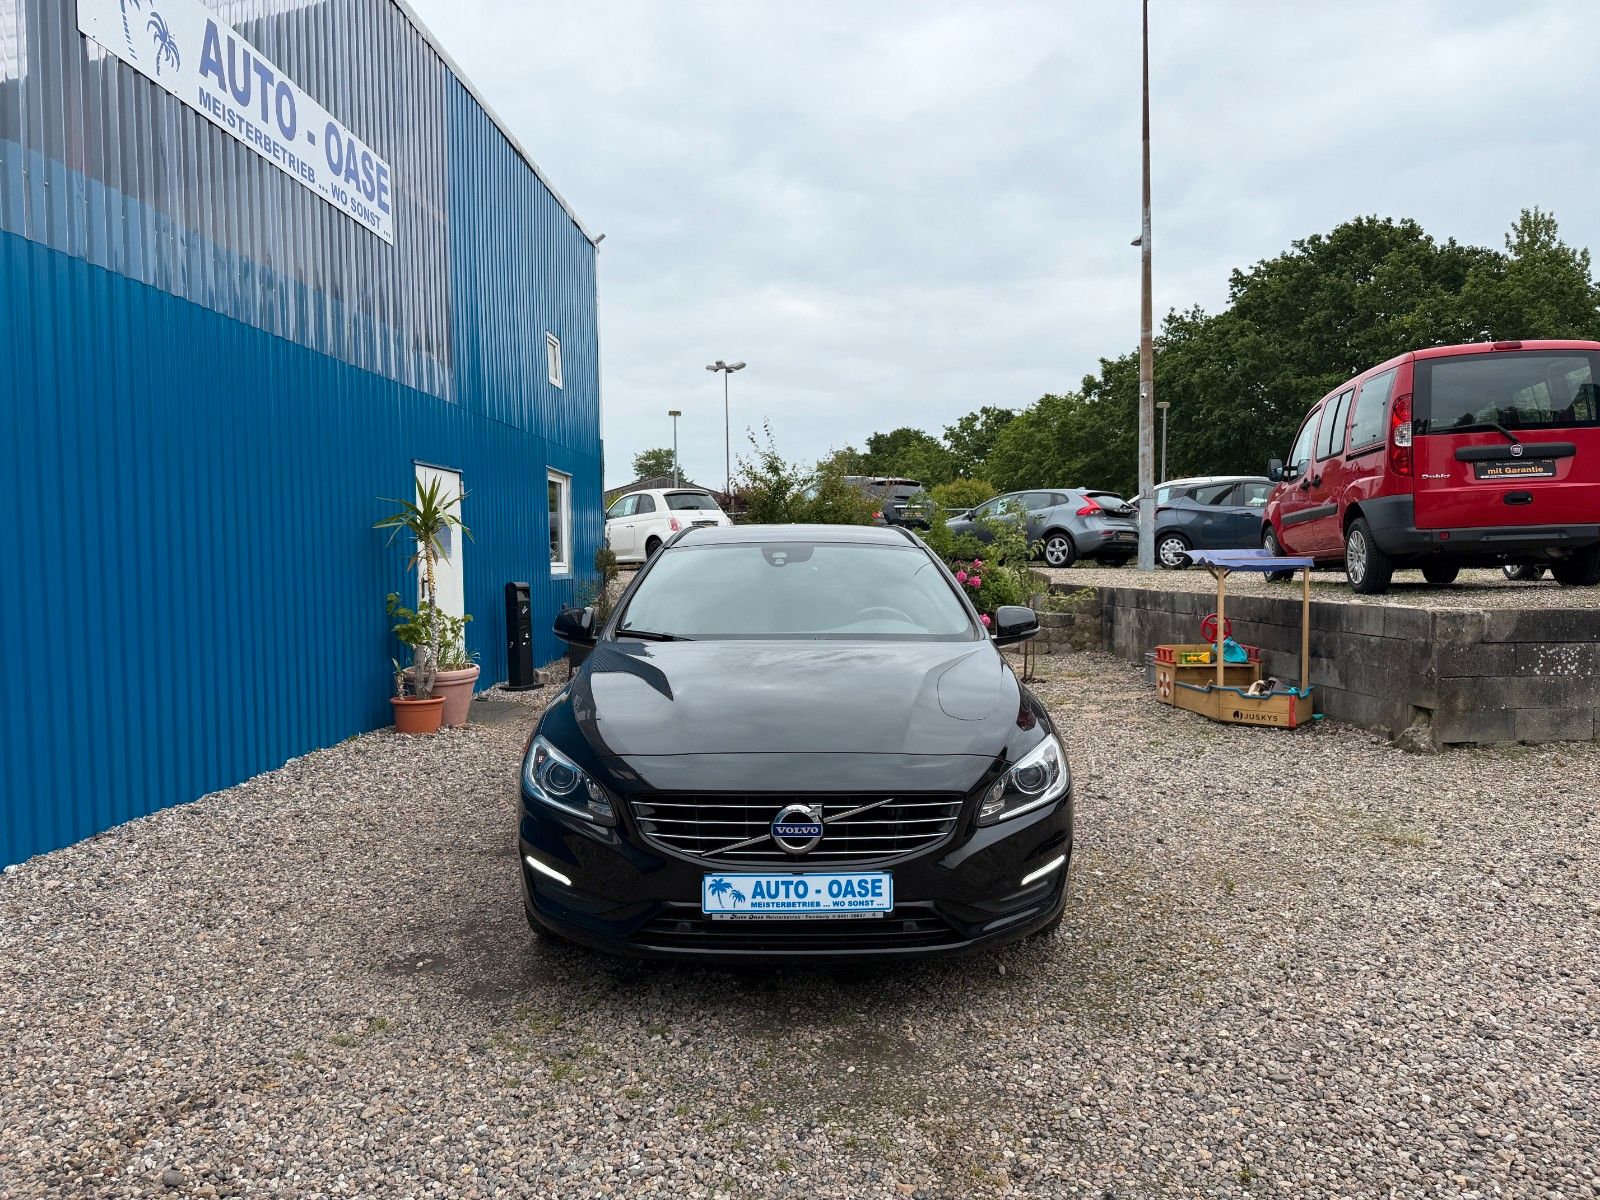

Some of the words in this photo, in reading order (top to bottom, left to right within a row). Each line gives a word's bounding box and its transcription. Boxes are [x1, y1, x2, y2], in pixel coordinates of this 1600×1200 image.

[199, 17, 297, 142] AUTO
[324, 121, 390, 216] OASE
[198, 86, 316, 184] MEISTERBETRIEB
[330, 181, 348, 206] WO
[350, 198, 382, 231] SONST
[1504, 466, 1544, 474] Garantie
[1243, 713, 1278, 722] JUSKYS
[775, 826, 819, 834] VOLVO
[751, 880, 809, 899] AUTO
[828, 878, 883, 899] OASE
